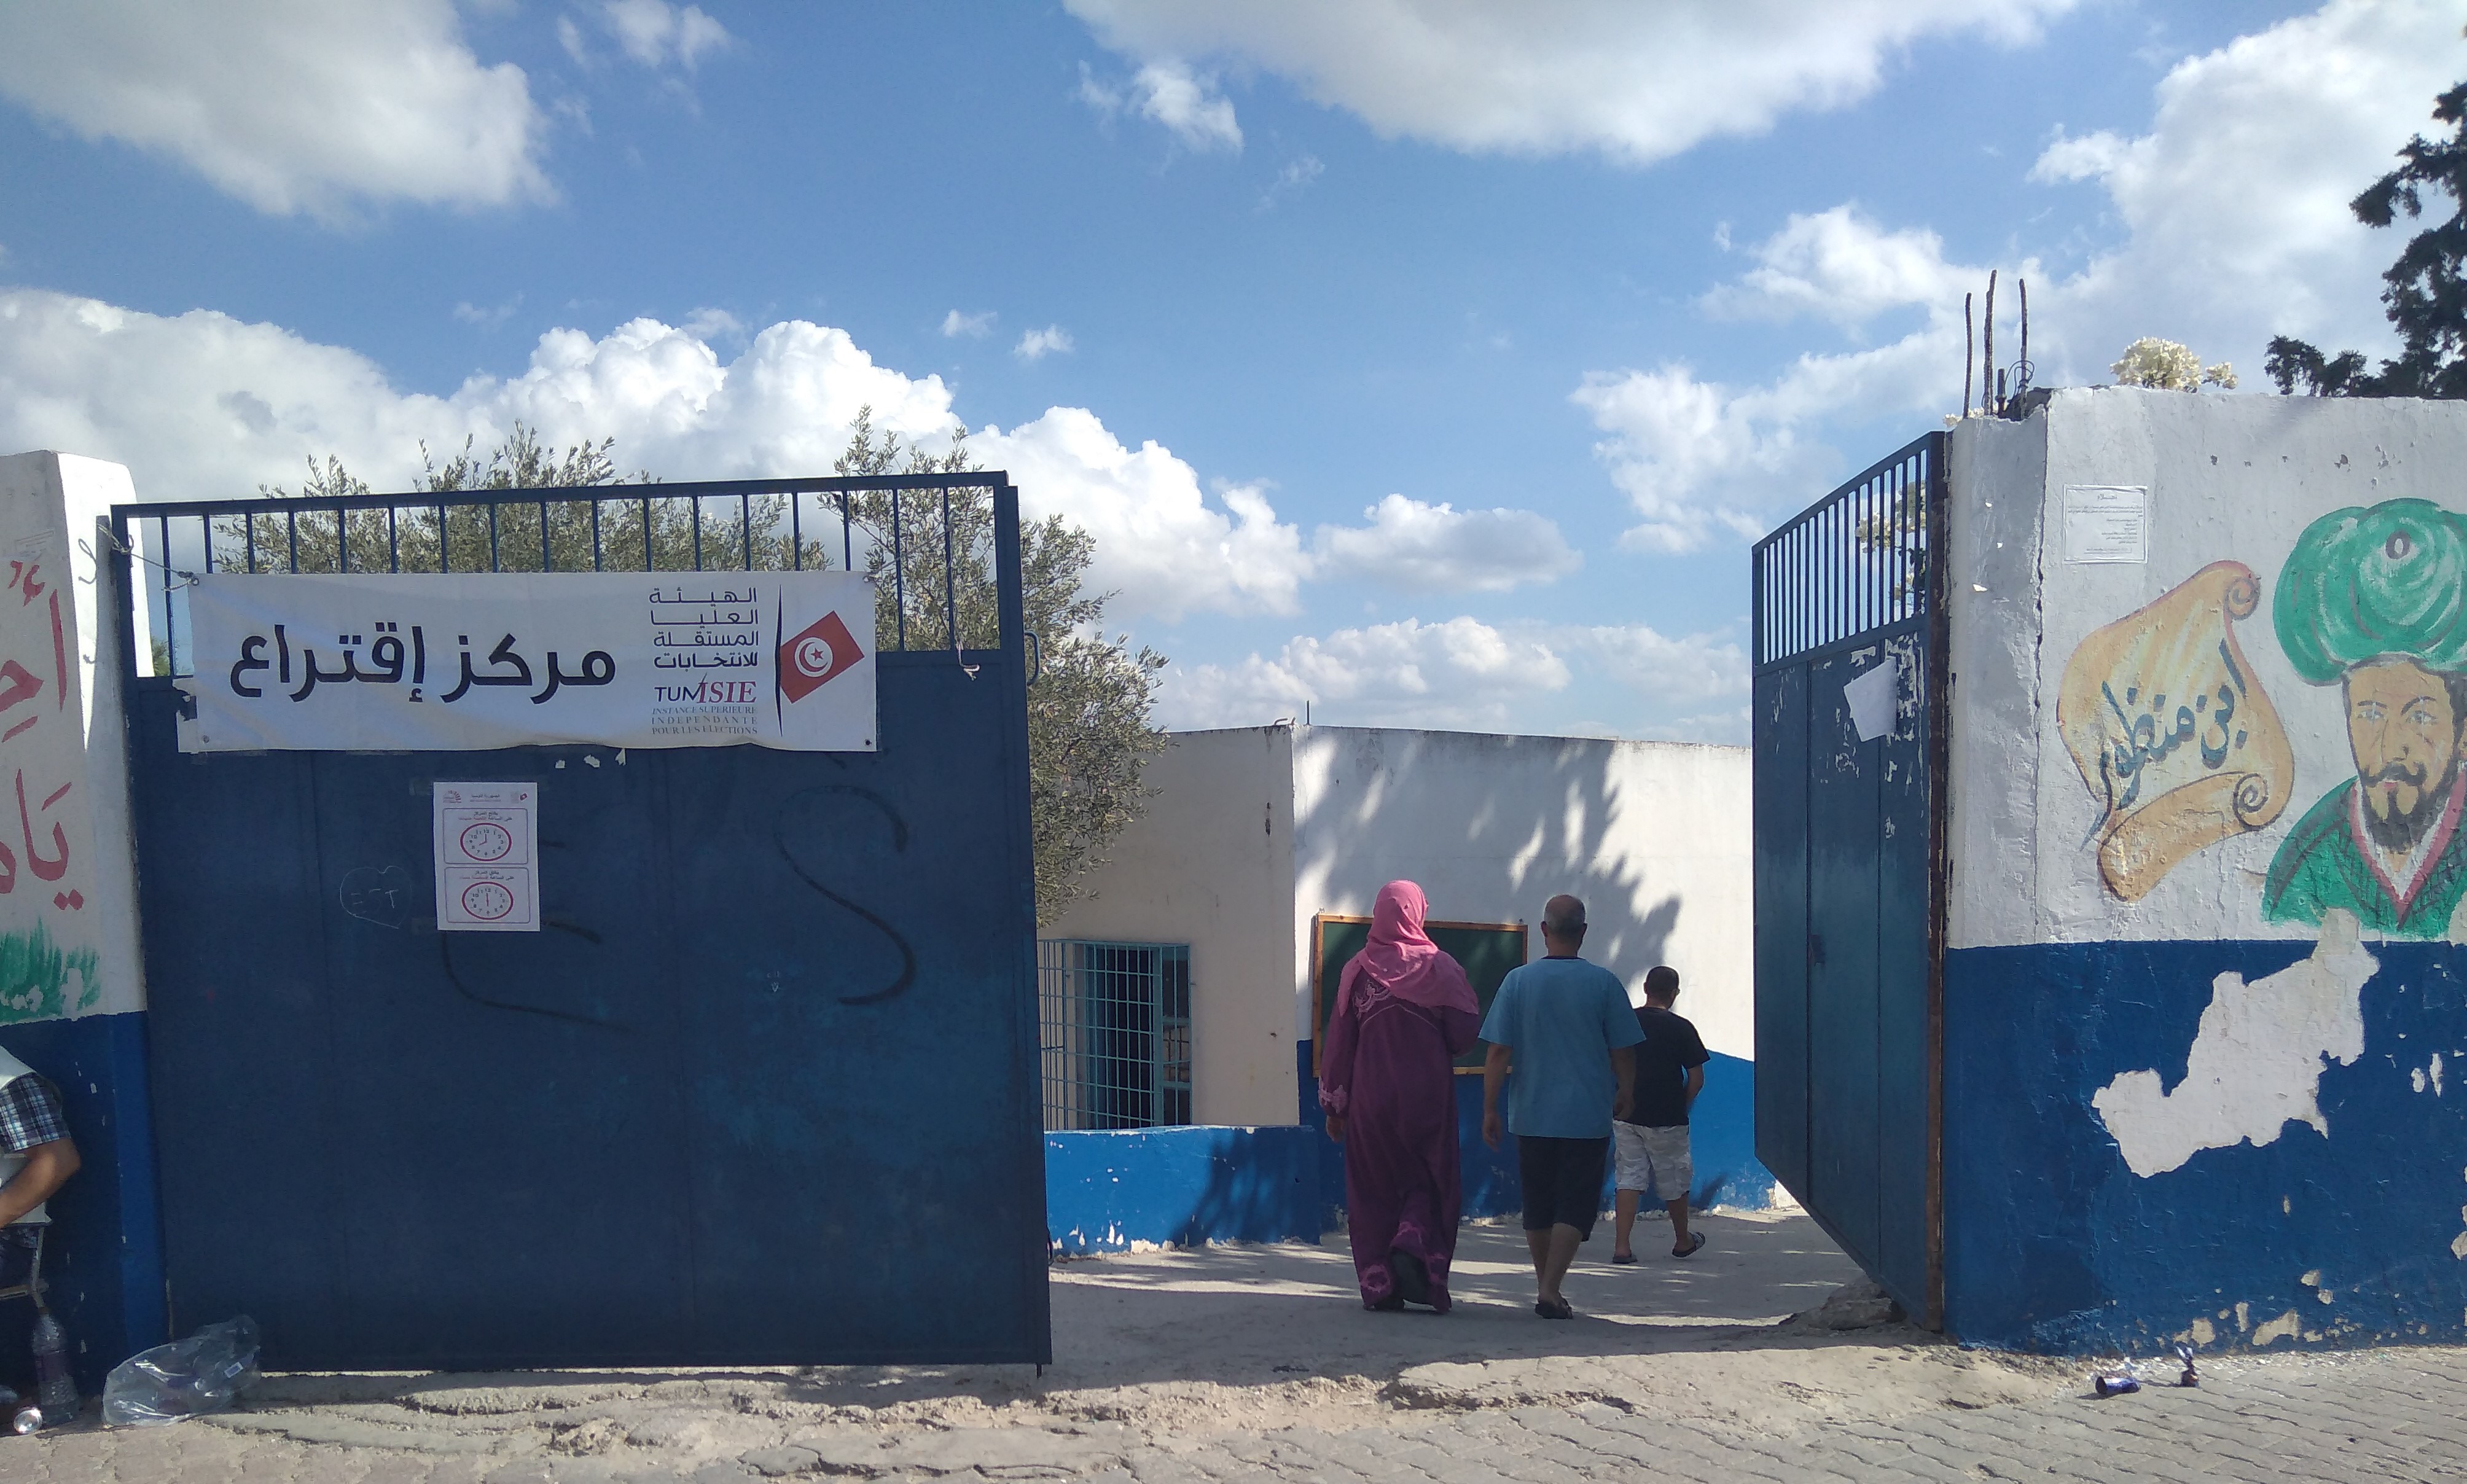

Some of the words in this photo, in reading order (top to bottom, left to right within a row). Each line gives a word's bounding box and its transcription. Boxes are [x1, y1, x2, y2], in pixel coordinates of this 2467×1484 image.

[649, 587, 758, 607] الهيئة
[650, 609, 759, 629] العليا
[653, 630, 759, 647] المستقلة
[230, 622, 426, 703] إقتراع
[439, 633, 616, 705] مركز
[654, 651, 759, 673] للانتخابات
